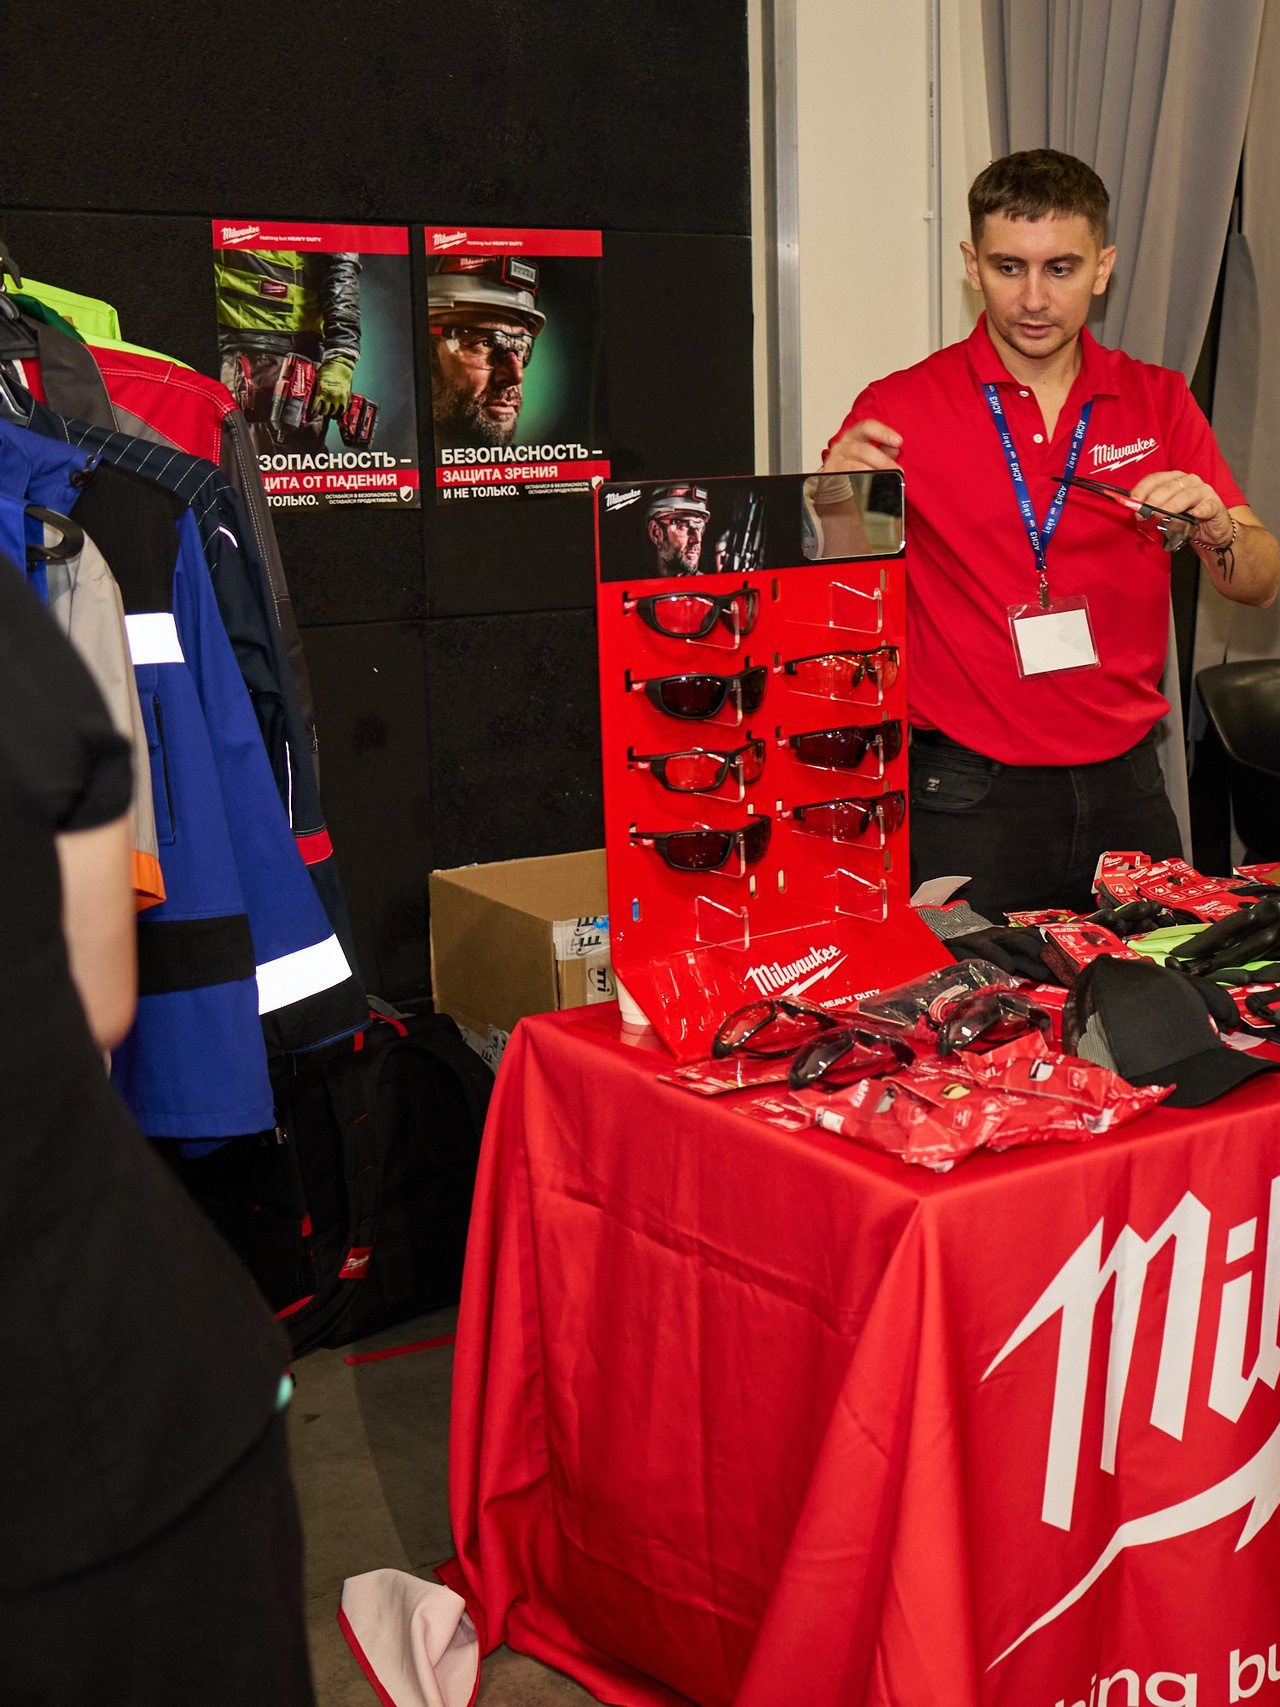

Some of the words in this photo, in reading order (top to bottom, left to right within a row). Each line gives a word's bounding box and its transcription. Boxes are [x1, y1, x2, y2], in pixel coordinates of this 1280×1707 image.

[221, 225, 260, 240] Milwaukee
[989, 395, 1003, 415] АСИЗ
[1075, 419, 1086, 439] АСИЗ
[256, 452, 396, 471] ЗОПАСНОСТЬ
[441, 444, 589, 465] БЕЗОПАСНОСТЬ
[1087, 437, 1157, 467] Milwaukee
[302, 475, 323, 488] ОТ
[326, 473, 397, 490] ПАДЕНИЯ
[442, 468, 502, 484] ЗАЩИТА
[504, 466, 558, 480] ЗРЕНИЯ
[1010, 462, 1023, 482] АСИЗ
[266, 495, 319, 507] ТОЛЬКО.
[443, 489, 451, 499] И
[453, 488, 469, 499] НЕ
[471, 486, 519, 498] ТОЛЬКО.
[604, 488, 642, 507] Milwaukee
[1054, 485, 1068, 505] АСИЗ
[1029, 531, 1040, 551] АСИЗ
[744, 944, 841, 996] Milwaukee
[819, 995, 853, 1009] HEAVY
[854, 988, 880, 1001] DUTY
